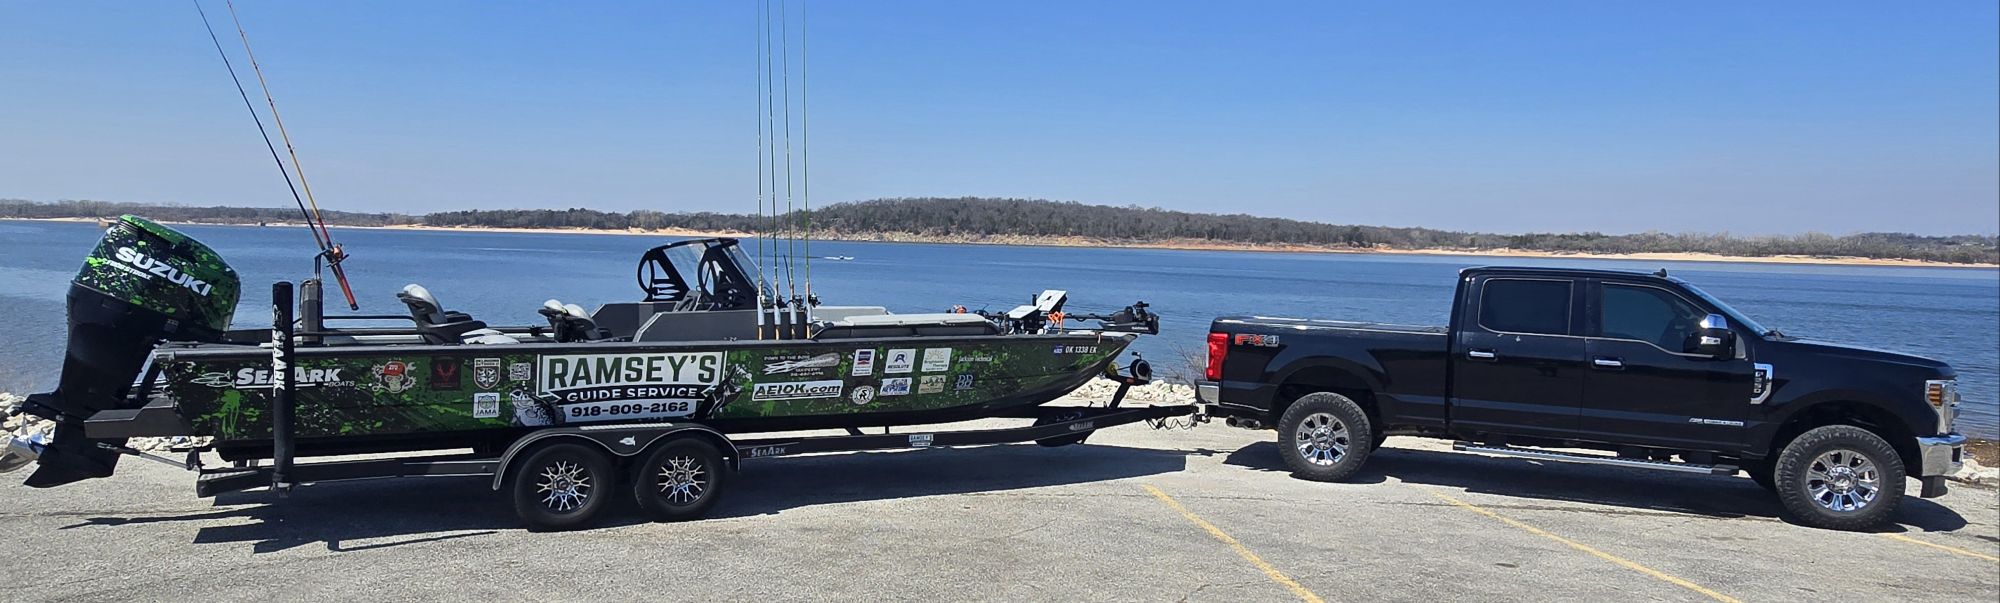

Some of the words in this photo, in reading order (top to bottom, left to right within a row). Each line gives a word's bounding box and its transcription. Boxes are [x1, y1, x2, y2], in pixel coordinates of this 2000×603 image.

[116, 247, 212, 296] SUZUKI
[1235, 334, 1279, 347] FX4
[549, 354, 717, 390] RAMSEY'S
[328, 380, 355, 388] BOATS
[754, 383, 841, 396] AEIOK.com
[566, 388, 621, 401] GUIDE
[626, 387, 698, 398] SERVICE
[571, 401, 689, 418] 918-809-2162
